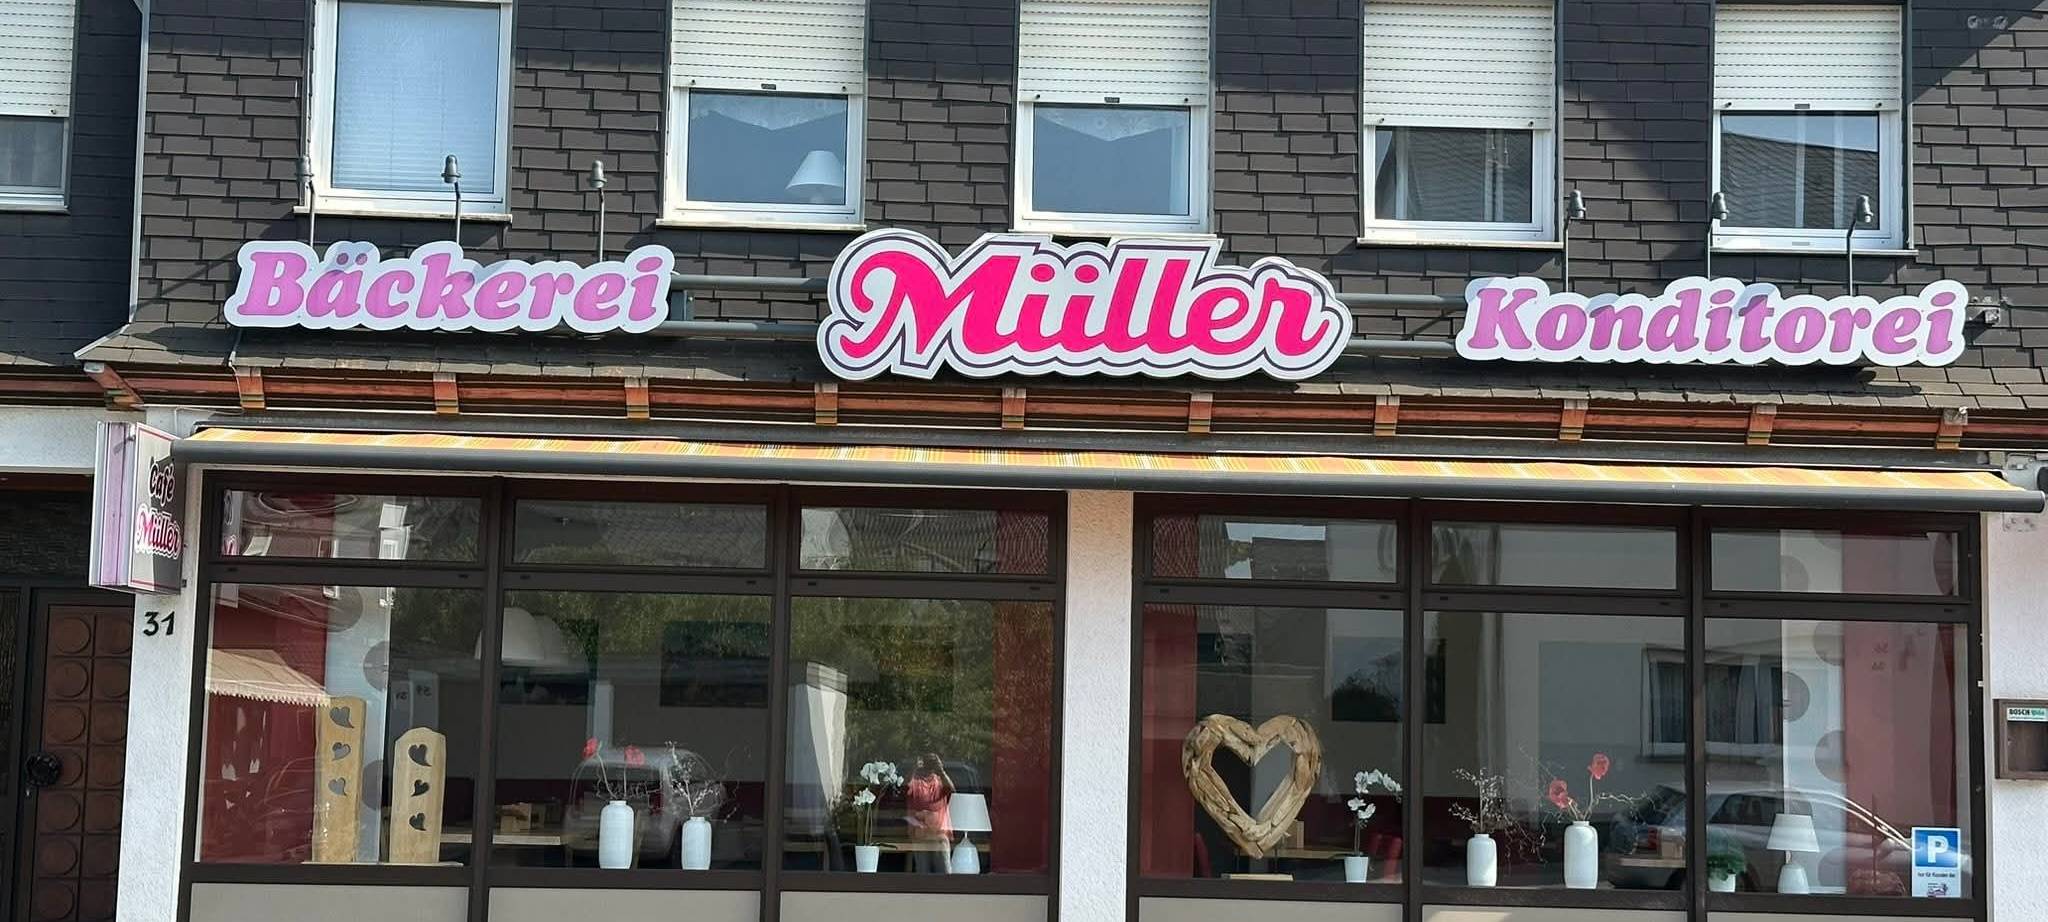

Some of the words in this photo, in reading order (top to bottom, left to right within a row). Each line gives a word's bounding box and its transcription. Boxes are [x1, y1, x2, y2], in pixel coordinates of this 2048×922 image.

[238, 251, 663, 322] Bäckerei
[840, 250, 1330, 359] Müller
[1468, 287, 1956, 355] Konditorei
[149, 464, 175, 504] Café
[137, 506, 181, 558] Müller
[143, 610, 175, 636] 31
[1927, 835, 1949, 863] P
